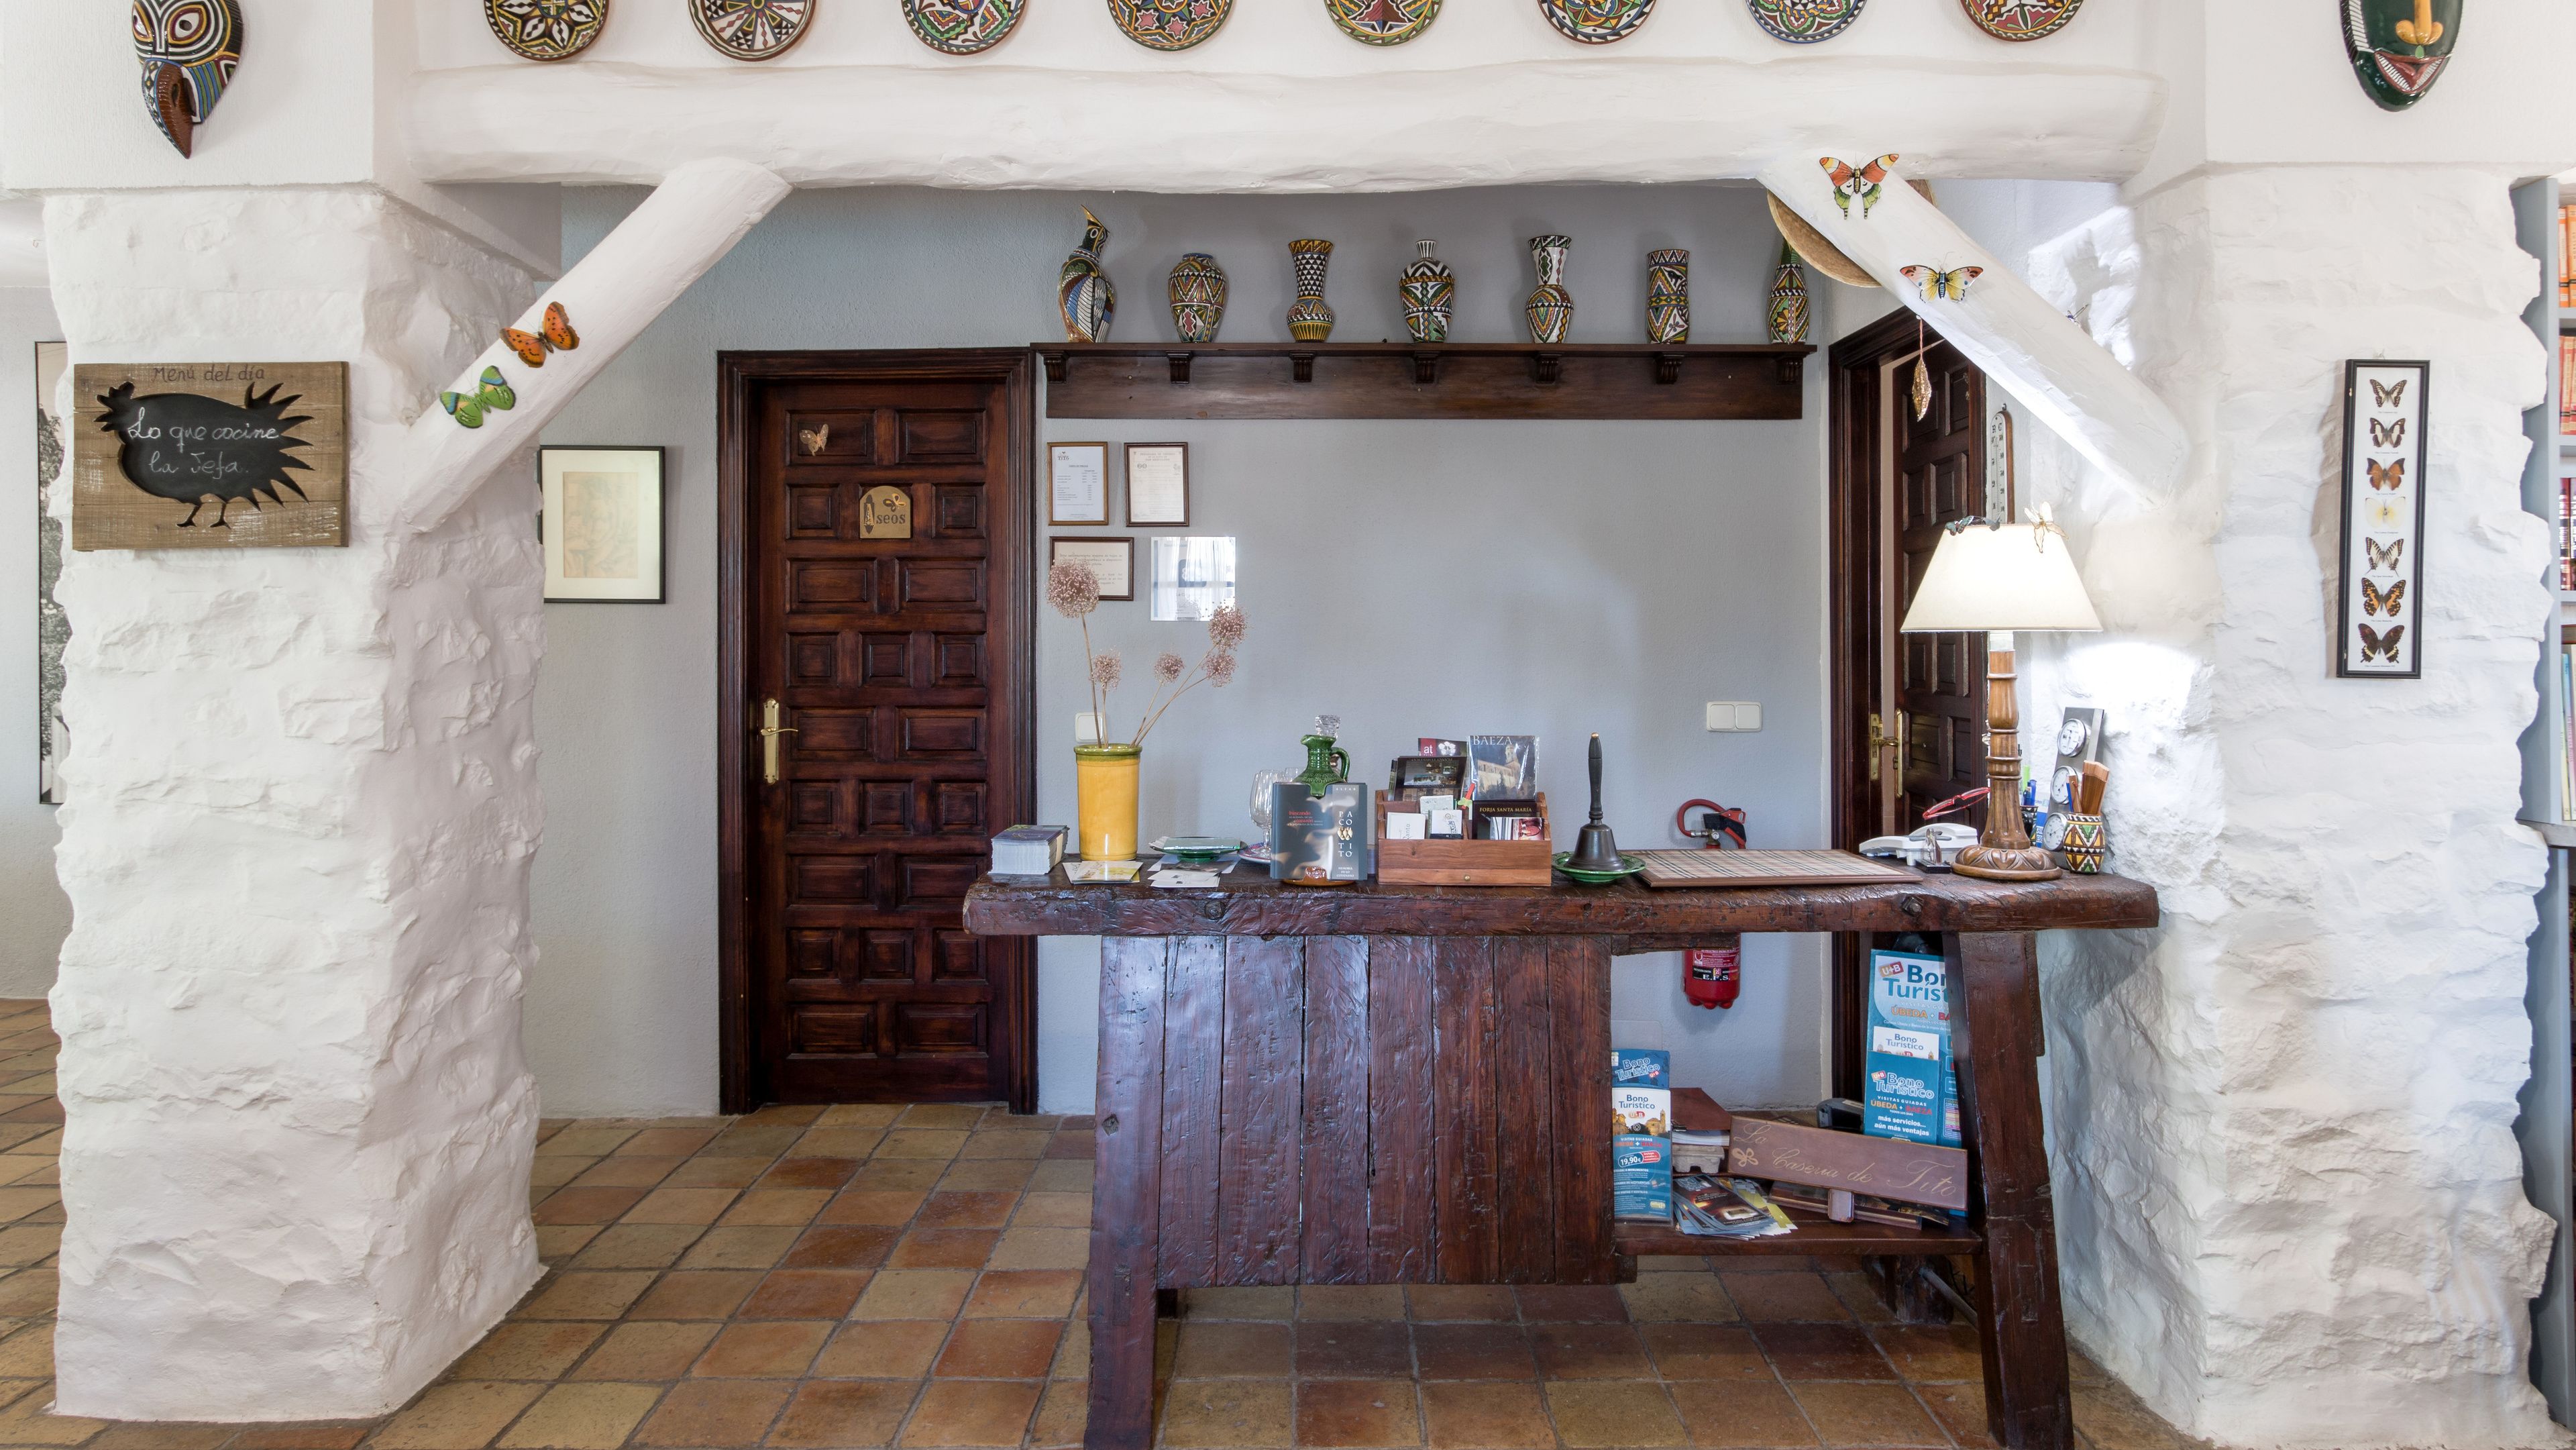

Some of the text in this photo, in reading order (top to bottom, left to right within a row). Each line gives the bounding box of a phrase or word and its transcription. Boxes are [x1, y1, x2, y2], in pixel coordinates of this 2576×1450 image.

[152, 365, 195, 382] Menú
[238, 365, 265, 381] día
[127, 407, 279, 453] Lo que cocine
[149, 450, 179, 474] la
[864, 501, 906, 527] Aseos
[1473, 735, 1512, 745] BAEZA
[1424, 745, 1433, 754] at
[1882, 962, 1901, 976] U+B
[1891, 1004, 1928, 1019] ÚBEDA
[1886, 1038, 1924, 1050] Turístico
[1894, 1033, 1917, 1043] Bono
[1623, 1057, 1650, 1070] Bono
[1615, 1064, 1660, 1081] Turístico
[1887, 1072, 1925, 1088] Bono
[1873, 1079, 1935, 1099] Turístico
[1619, 1100, 1656, 1109] Turístico
[1870, 1100, 1898, 1109] ÚBEDA
[1892, 1118, 1927, 1128] servicios...
[1734, 1123, 1772, 1144] La
[1902, 1127, 1929, 1136] ventajas
[1621, 1157, 1641, 1166] 19,90€
[1847, 1163, 1874, 1183] de
